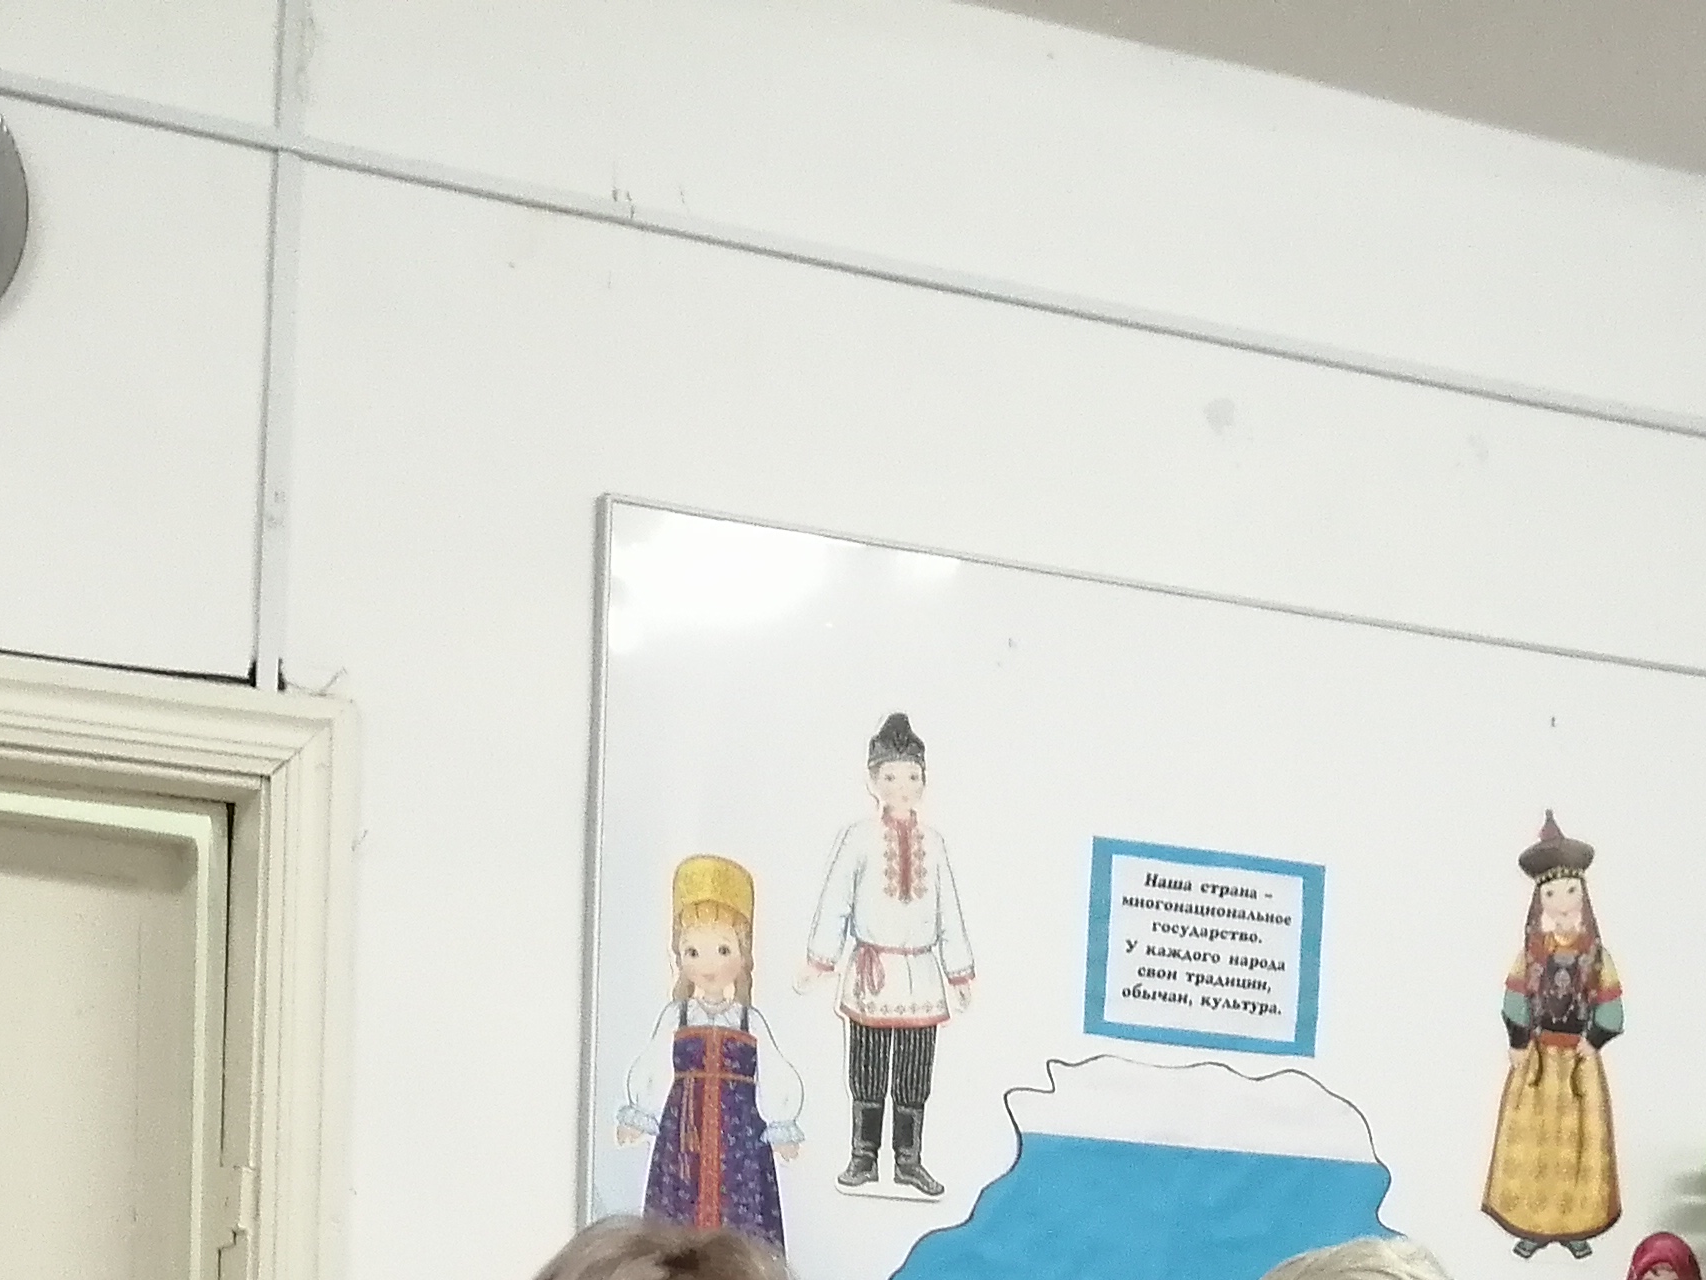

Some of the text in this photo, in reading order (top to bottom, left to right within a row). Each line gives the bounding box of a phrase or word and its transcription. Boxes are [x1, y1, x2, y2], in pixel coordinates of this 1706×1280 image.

[1144, 872, 1192, 892] Наша
[1200, 882, 1258, 900] страна
[1121, 896, 1293, 926] многонациональное
[1151, 920, 1263, 944] государство.
[1125, 939, 1286, 972] У каждого народа
[1137, 966, 1272, 994] свои традиции,
[1121, 983, 1282, 1017] обычаи, культура.
